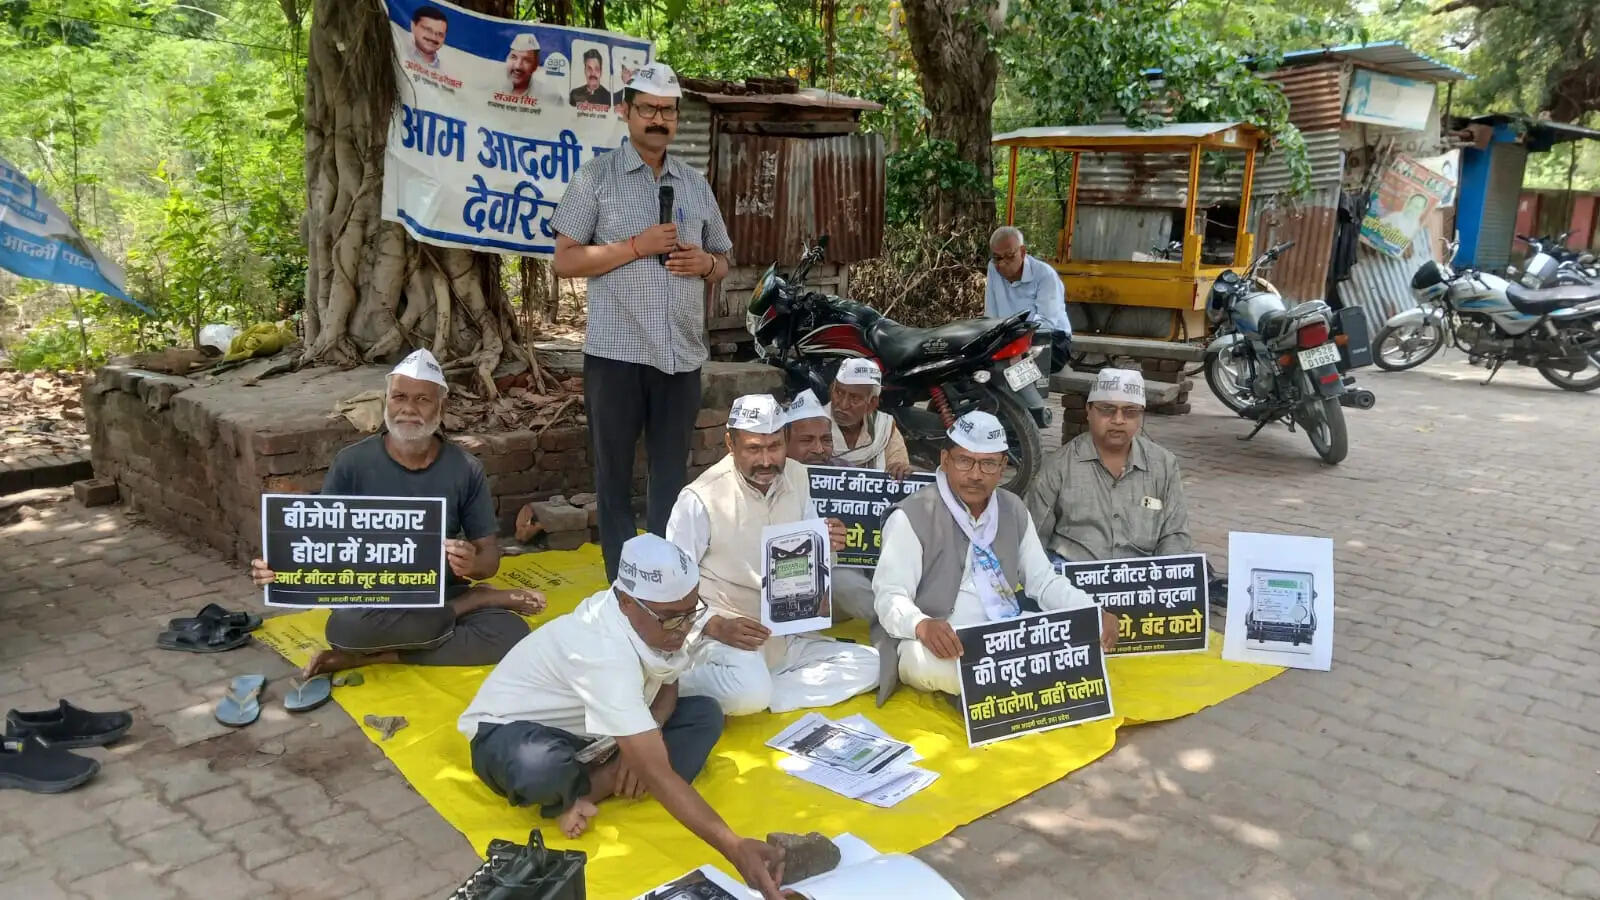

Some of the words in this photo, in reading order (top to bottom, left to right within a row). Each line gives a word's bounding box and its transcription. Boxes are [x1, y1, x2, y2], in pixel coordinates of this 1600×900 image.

[400, 103, 467, 162] आम
[478, 129, 583, 183] आदमी
[462, 174, 557, 240] देवरिय
[810, 472, 847, 491] स्मार्ट
[848, 473, 885, 493] मीटर
[282, 501, 347, 530] बीजेपी
[349, 508, 427, 530] सरकार
[830, 499, 870, 516] जनता
[290, 535, 335, 563] होश
[337, 537, 363, 564] में
[364, 538, 417, 564] आओ
[273, 568, 303, 585] स्मार्ट
[304, 569, 336, 585] मीटर
[337, 569, 355, 585] की
[356, 572, 378, 589] लूट
[379, 570, 397, 585] बंद
[398, 569, 437, 585] कराओ
[639, 569, 663, 584] पार्टी
[1074, 565, 1110, 586] स्मार्ट
[1110, 564, 1147, 583] मीटर
[1148, 562, 1163, 581] के
[1164, 563, 1195, 580] नाम
[1096, 590, 1136, 607] जनता
[1138, 585, 1157, 604] को
[1158, 586, 1197, 608] लूटना
[983, 621, 1027, 655] स्मार्ट
[1028, 617, 1072, 645] मीटर
[1140, 613, 1165, 636] बंद
[1168, 609, 1203, 633] करो
[973, 656, 996, 686] की
[998, 656, 1027, 688] लूट
[1028, 651, 1051, 675] का
[1053, 642, 1090, 671] खेल
[969, 695, 997, 721] नहीं
[997, 691, 1039, 715] चलेगा,
[1039, 681, 1067, 706] नहीं
[1067, 677, 1105, 700] चलेगा
